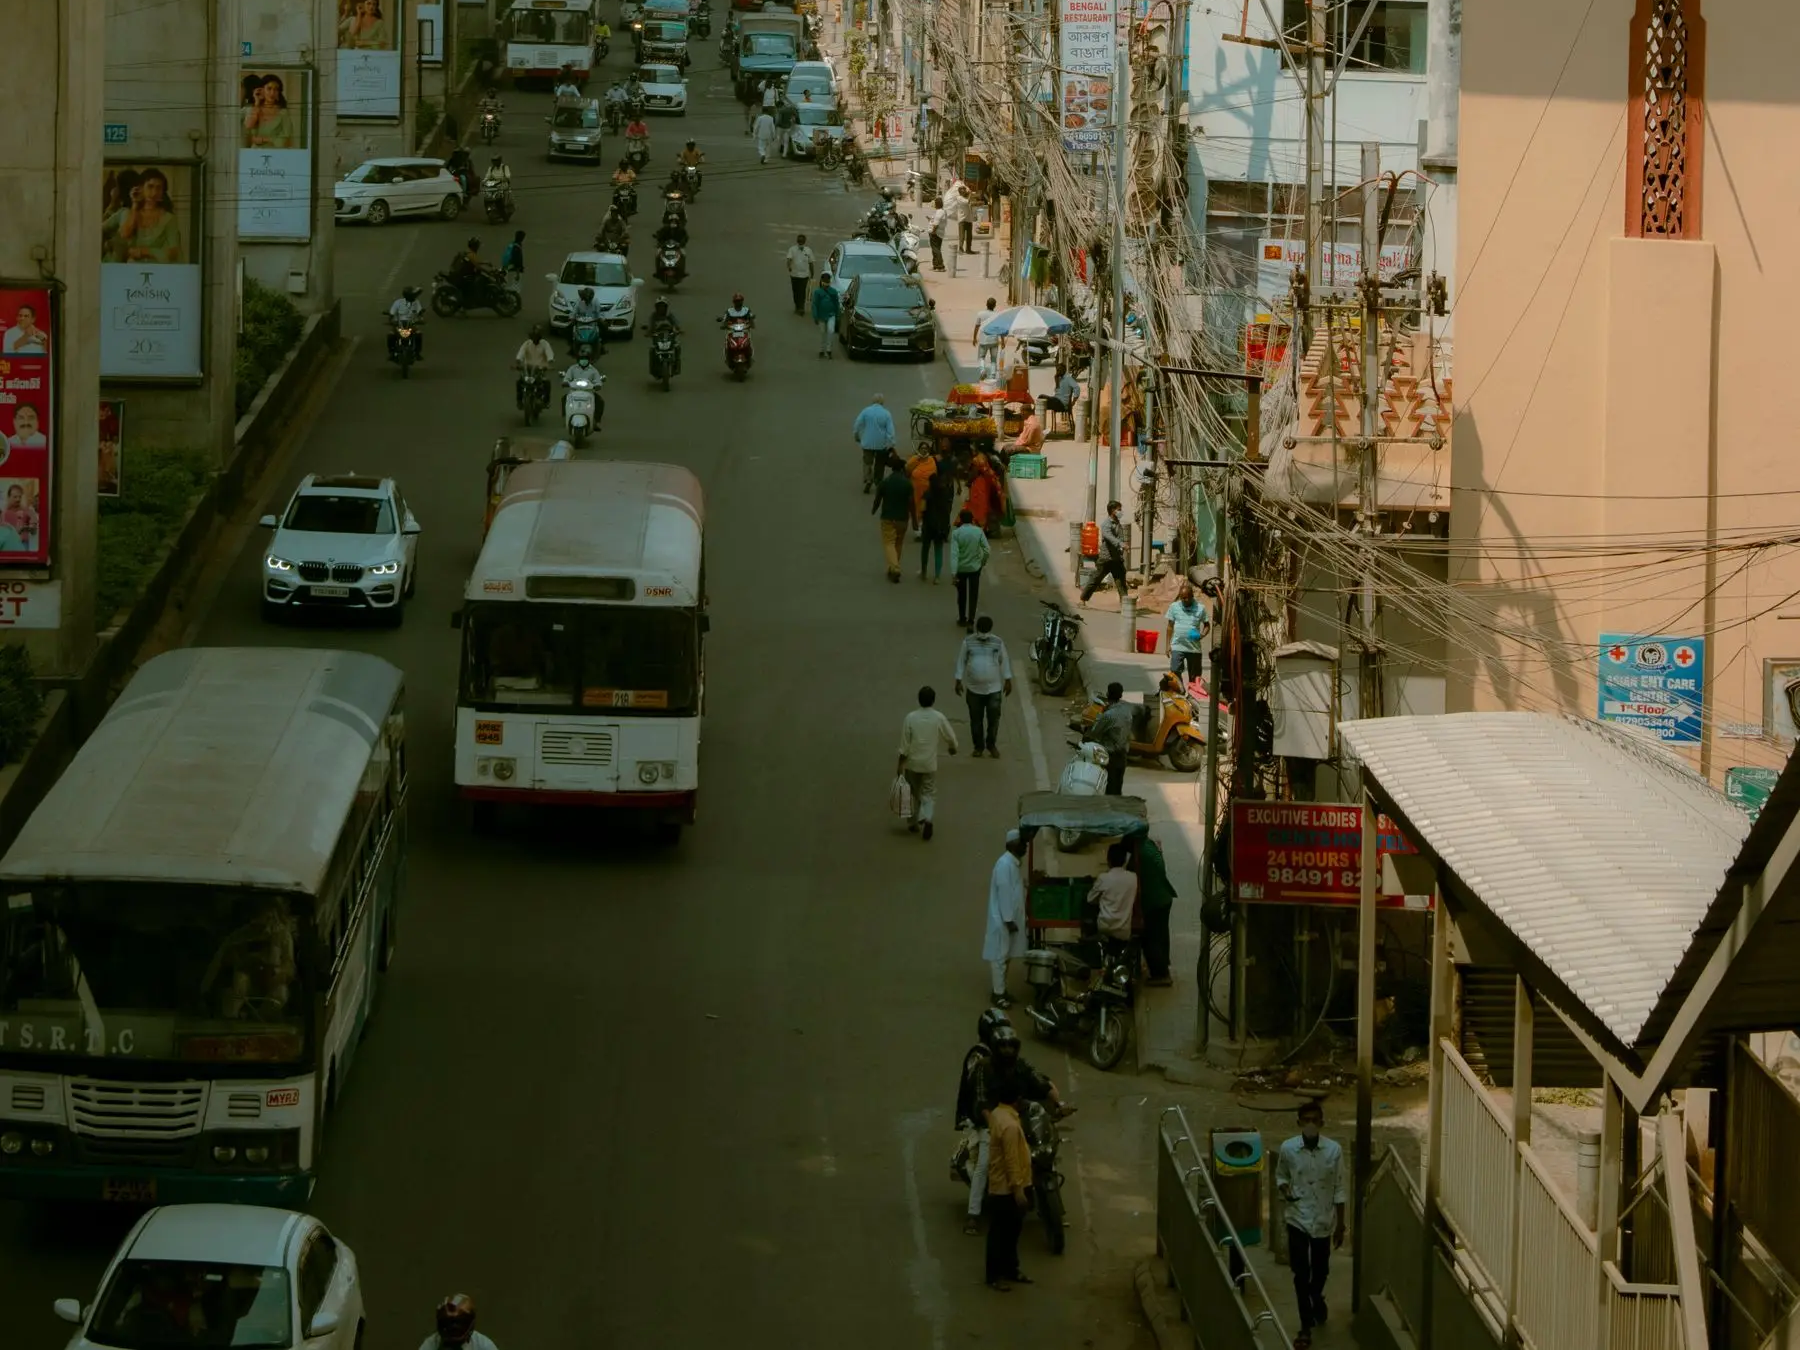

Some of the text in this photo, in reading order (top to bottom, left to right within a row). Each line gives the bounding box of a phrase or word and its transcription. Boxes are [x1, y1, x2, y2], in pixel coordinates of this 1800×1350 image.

[1069, 2, 1107, 11] BENGALI
[1063, 14, 1113, 23] RESTAURANT
[106, 126, 126, 141] 125
[123, 287, 171, 303] TANISHQ
[646, 587, 672, 597] DSNR
[0, 597, 28, 617] T
[1667, 678, 1695, 690] CARE
[1630, 690, 1671, 703] CENTRE
[1637, 703, 1668, 715] Floor
[1247, 808, 1309, 825] EXCUTIVE
[1312, 811, 1357, 827] LADIES
[1334, 831, 1408, 851] HOTEL
[1267, 850, 1287, 866] 24
[1292, 851, 1350, 867] HOURS
[1267, 867, 1334, 886] 98491
